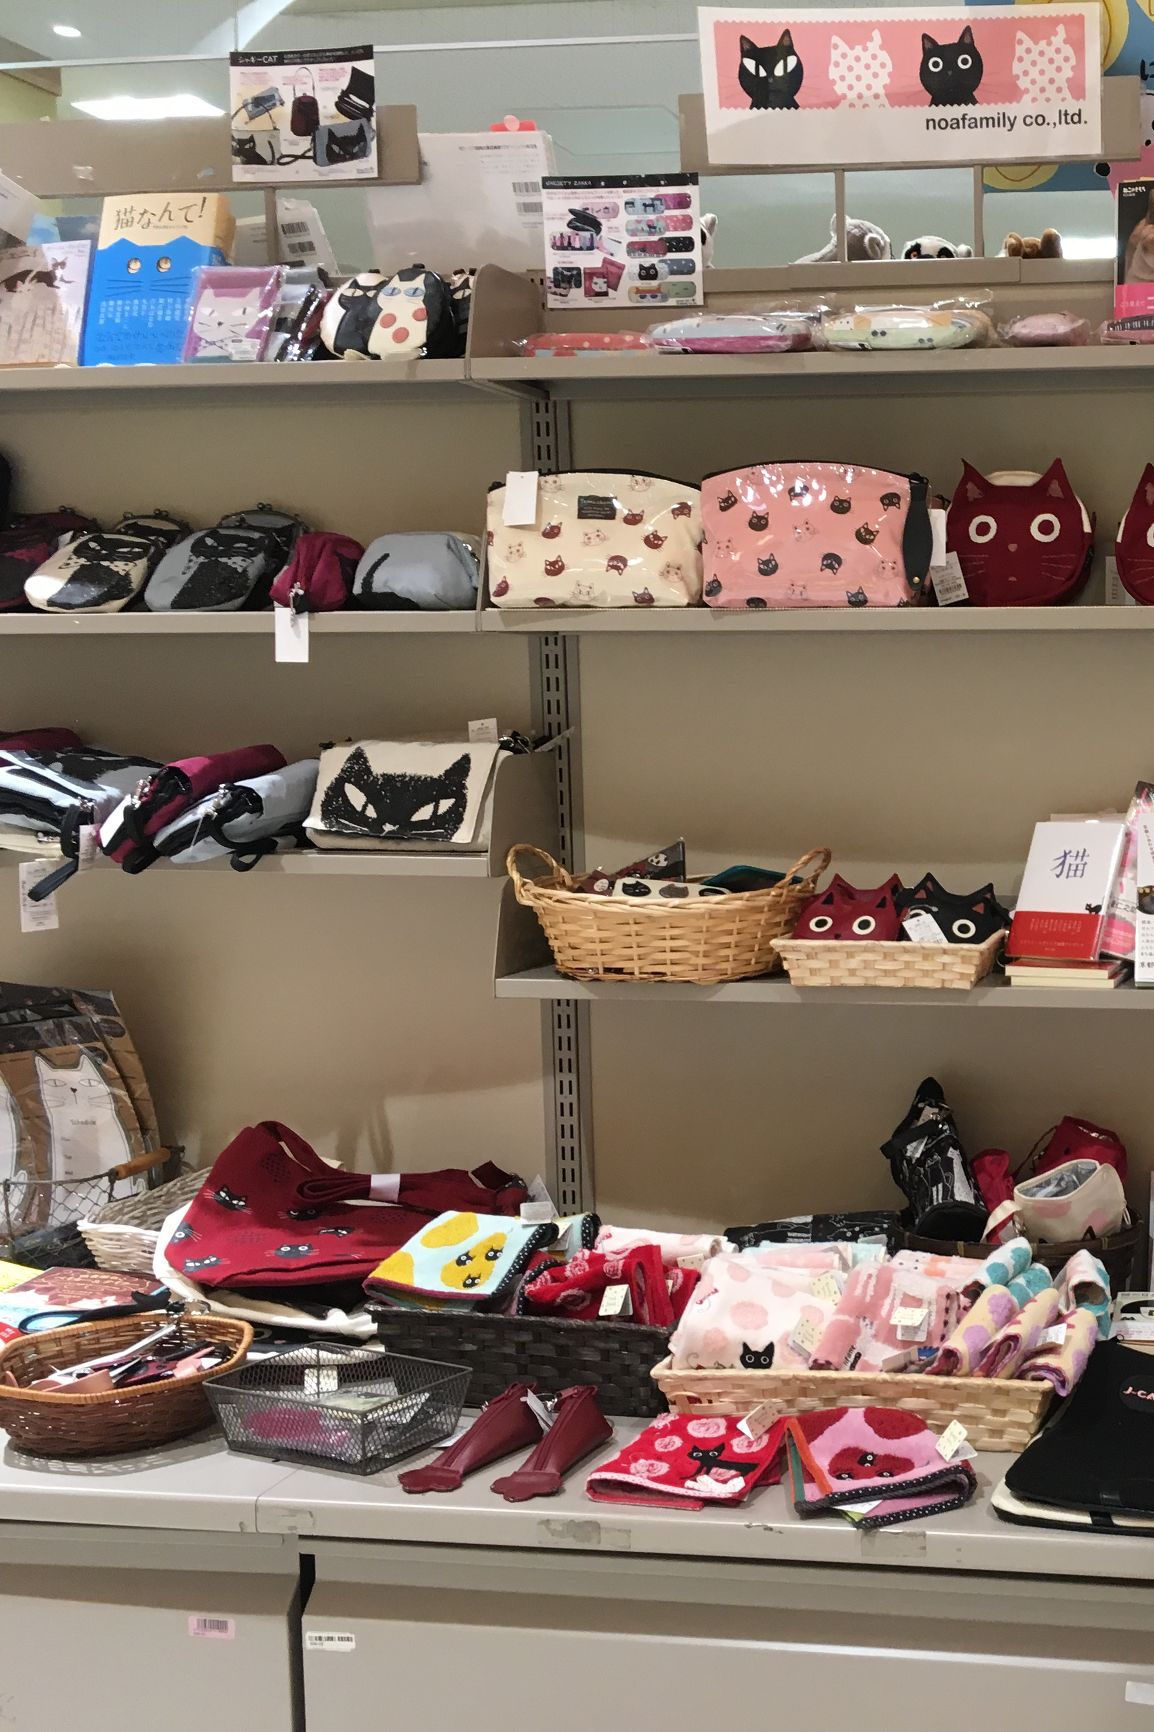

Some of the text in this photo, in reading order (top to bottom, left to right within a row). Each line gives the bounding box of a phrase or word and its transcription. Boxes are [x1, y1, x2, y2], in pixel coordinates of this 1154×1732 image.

[925, 108, 1088, 132] noafamily co.,ltd.
[113, 196, 207, 231] 猫なんて!
[1050, 847, 1090, 880] 猫
